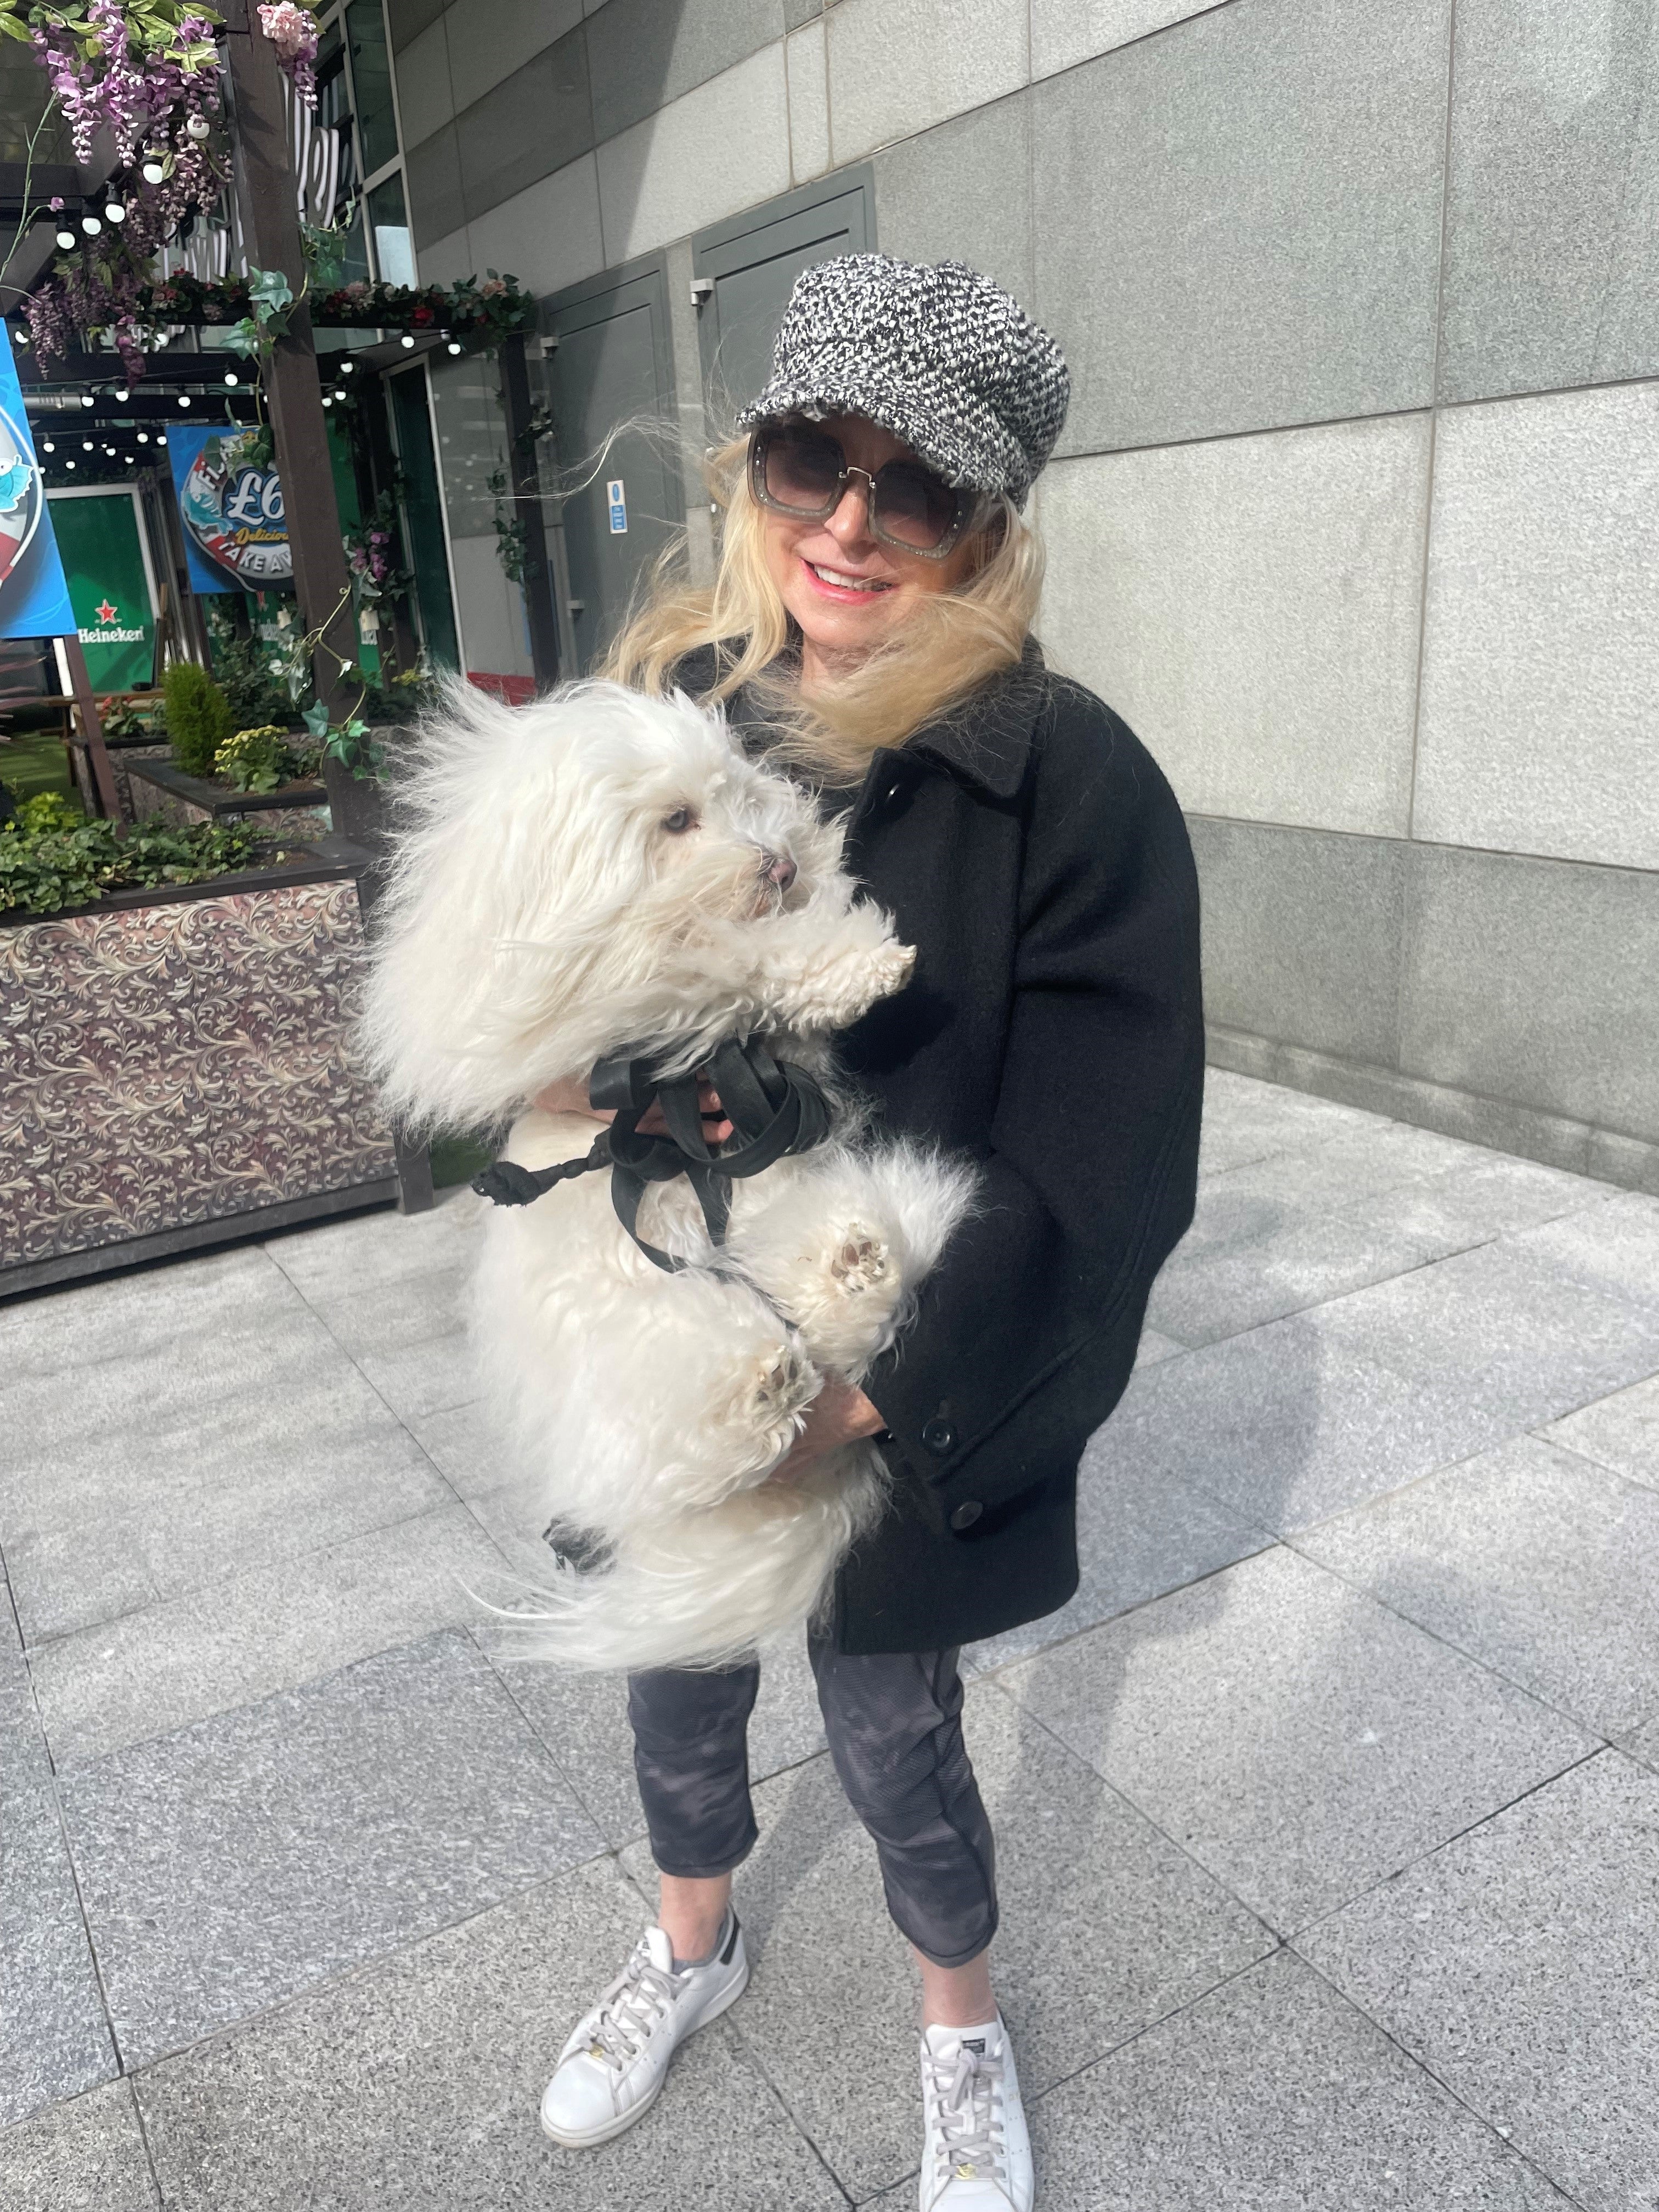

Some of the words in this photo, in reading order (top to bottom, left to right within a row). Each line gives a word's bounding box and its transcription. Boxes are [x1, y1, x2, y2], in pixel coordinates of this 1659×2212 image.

[235, 526, 289, 545] Deliciou
[218, 541, 265, 572] TAKE
[77, 625, 145, 644] Heineken
